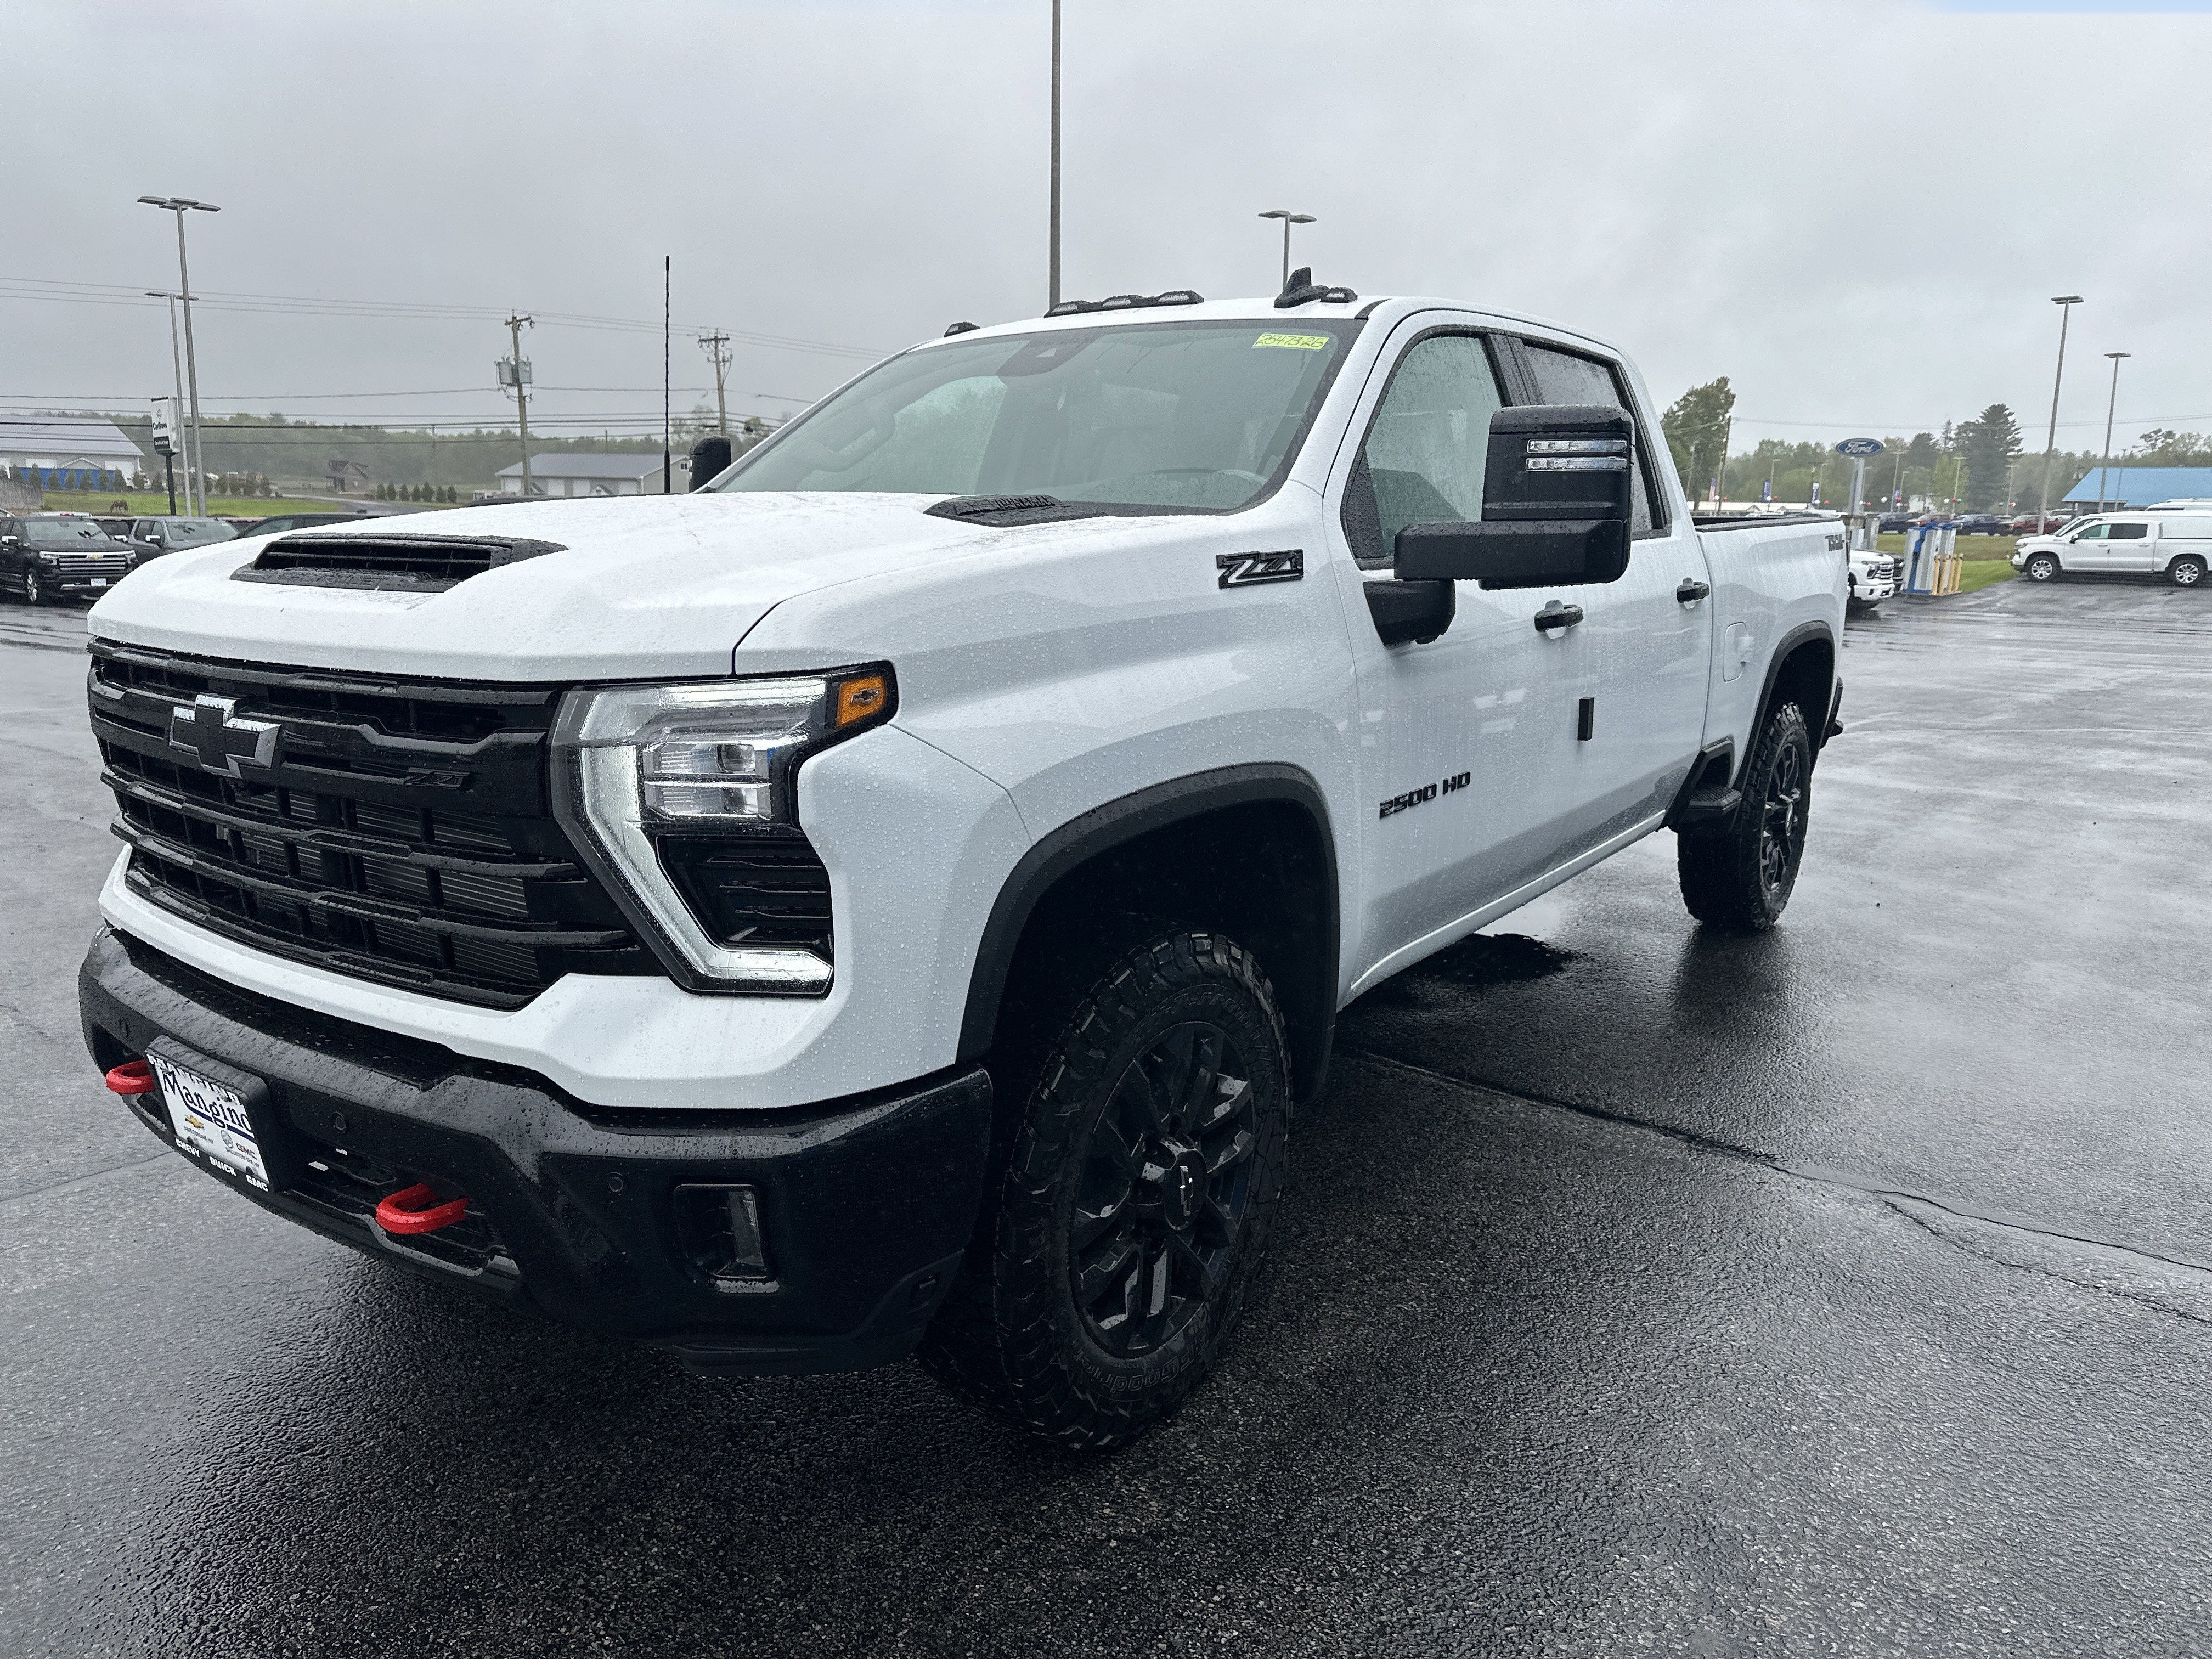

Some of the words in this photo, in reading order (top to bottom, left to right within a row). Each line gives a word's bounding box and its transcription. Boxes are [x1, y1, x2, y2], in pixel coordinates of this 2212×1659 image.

[1844, 441, 1875, 453] Ford
[1216, 549, 1304, 589] Z71
[1379, 782, 1437, 819] 2500
[1442, 770, 1471, 795] HD
[162, 1070, 253, 1133] Mangino
[175, 1138, 200, 1158] CHEVY
[209, 1156, 237, 1177] BUICK
[245, 1175, 269, 1192] GMC
